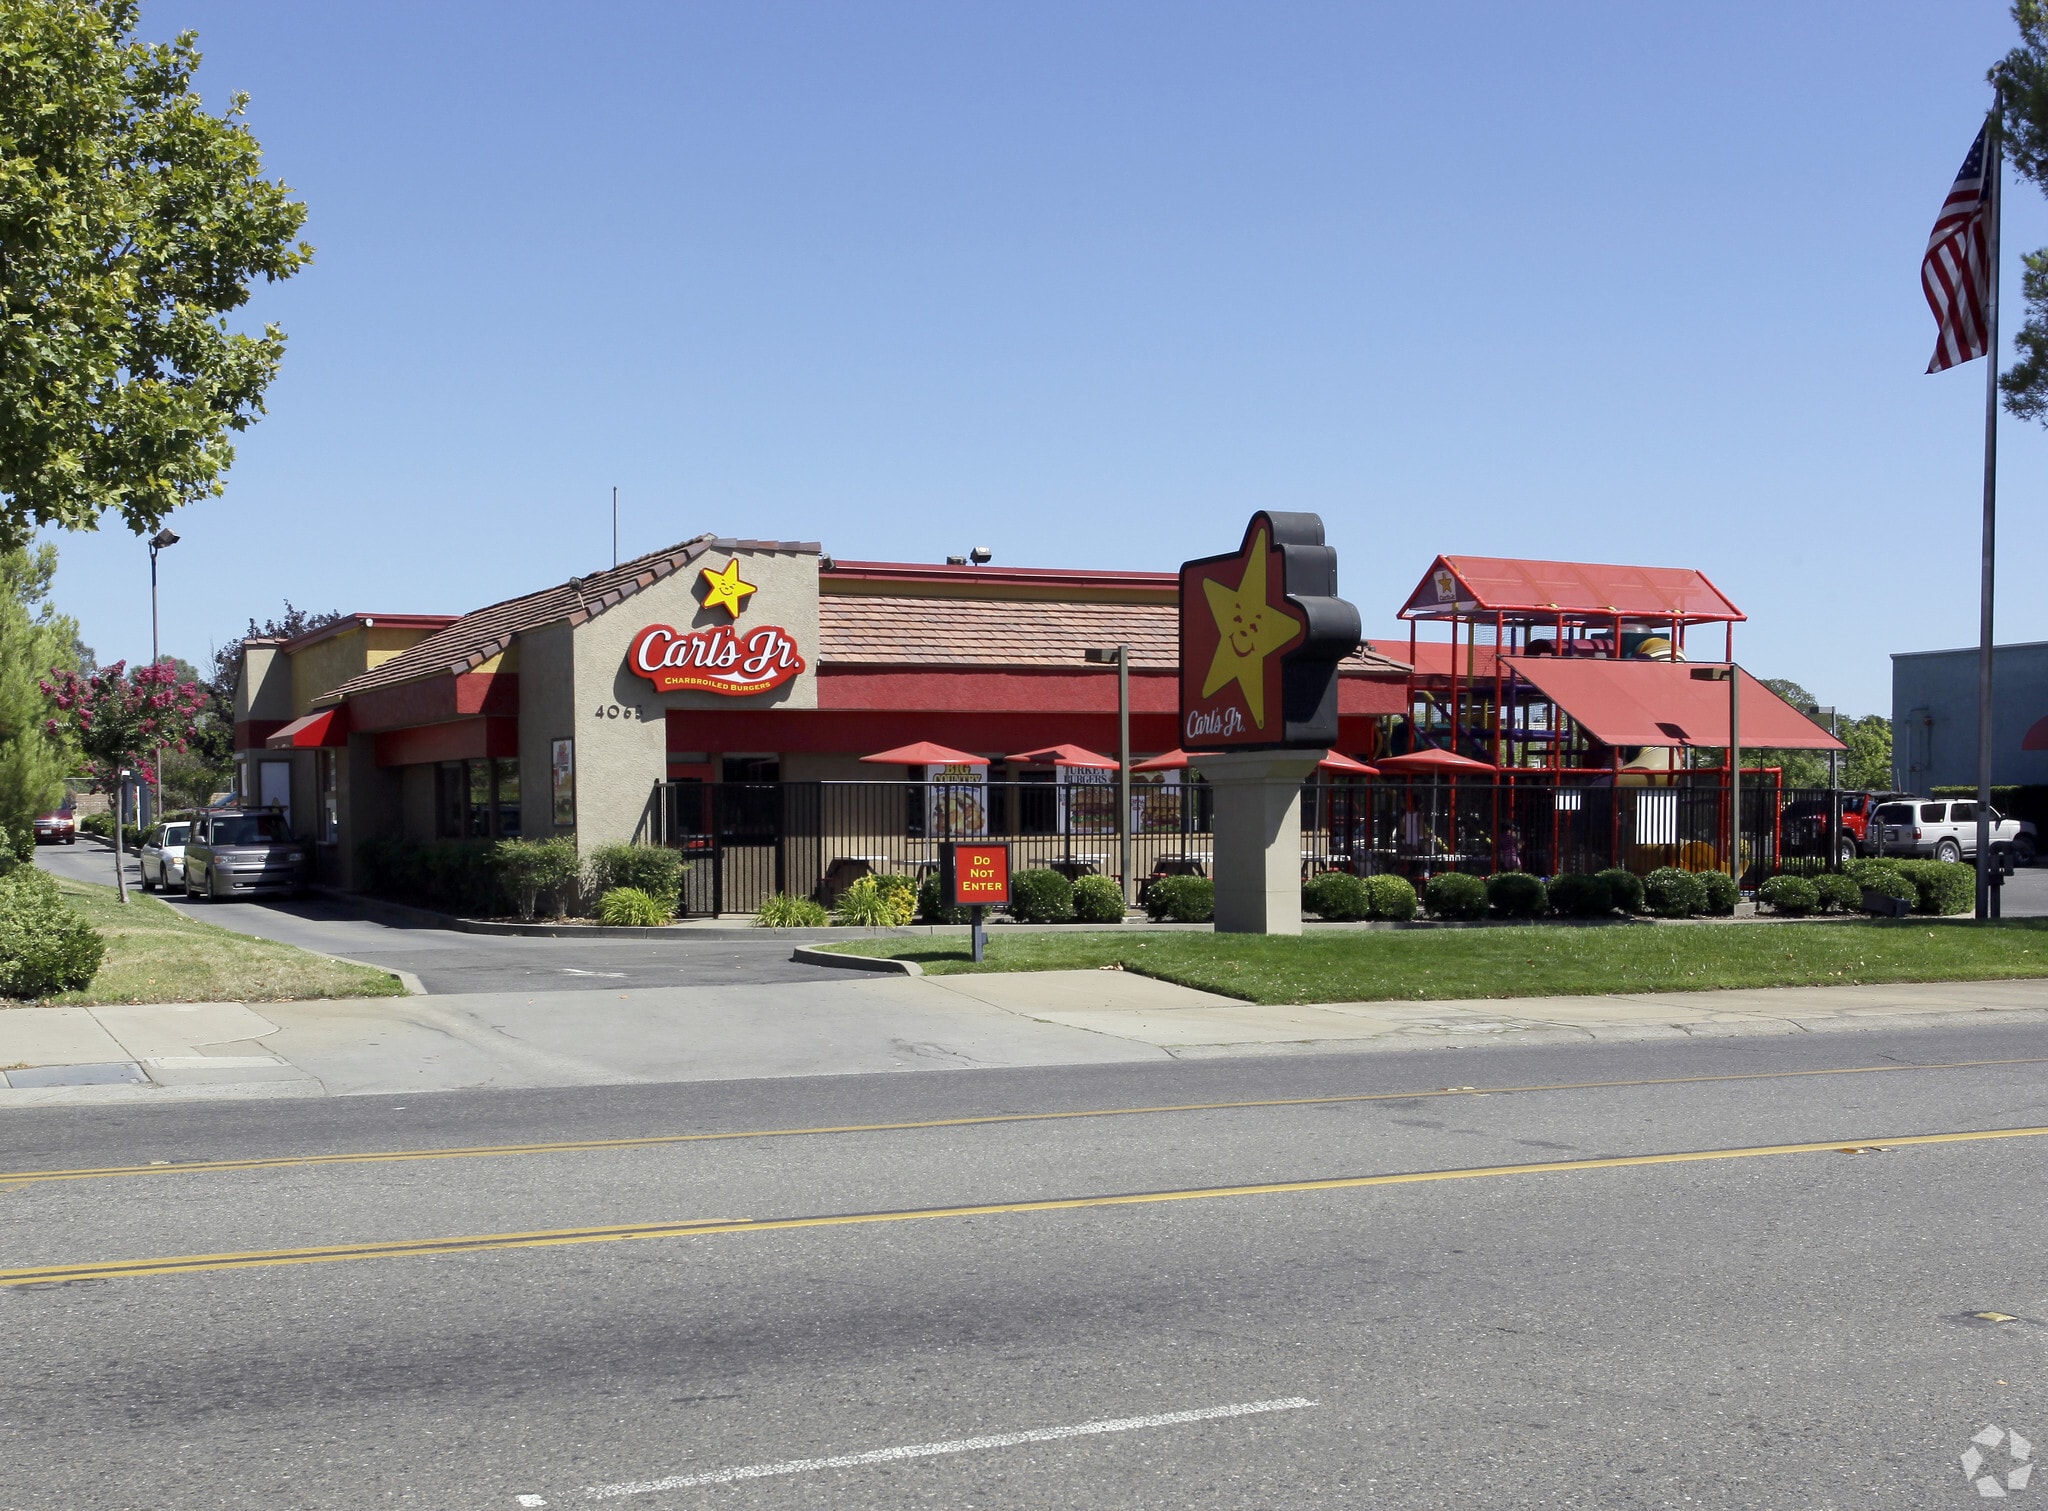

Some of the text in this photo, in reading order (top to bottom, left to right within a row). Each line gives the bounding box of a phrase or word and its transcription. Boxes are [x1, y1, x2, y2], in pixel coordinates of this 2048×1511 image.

[638, 629, 800, 673] Carl's Jr.
[664, 677, 771, 692] CHARBROILED BURGERS
[595, 704, 644, 720] 4065
[1186, 707, 1223, 739] Carl's
[945, 764, 970, 775] BIG
[1063, 765, 1105, 775] URKEY
[934, 774, 981, 783] COUNTRY
